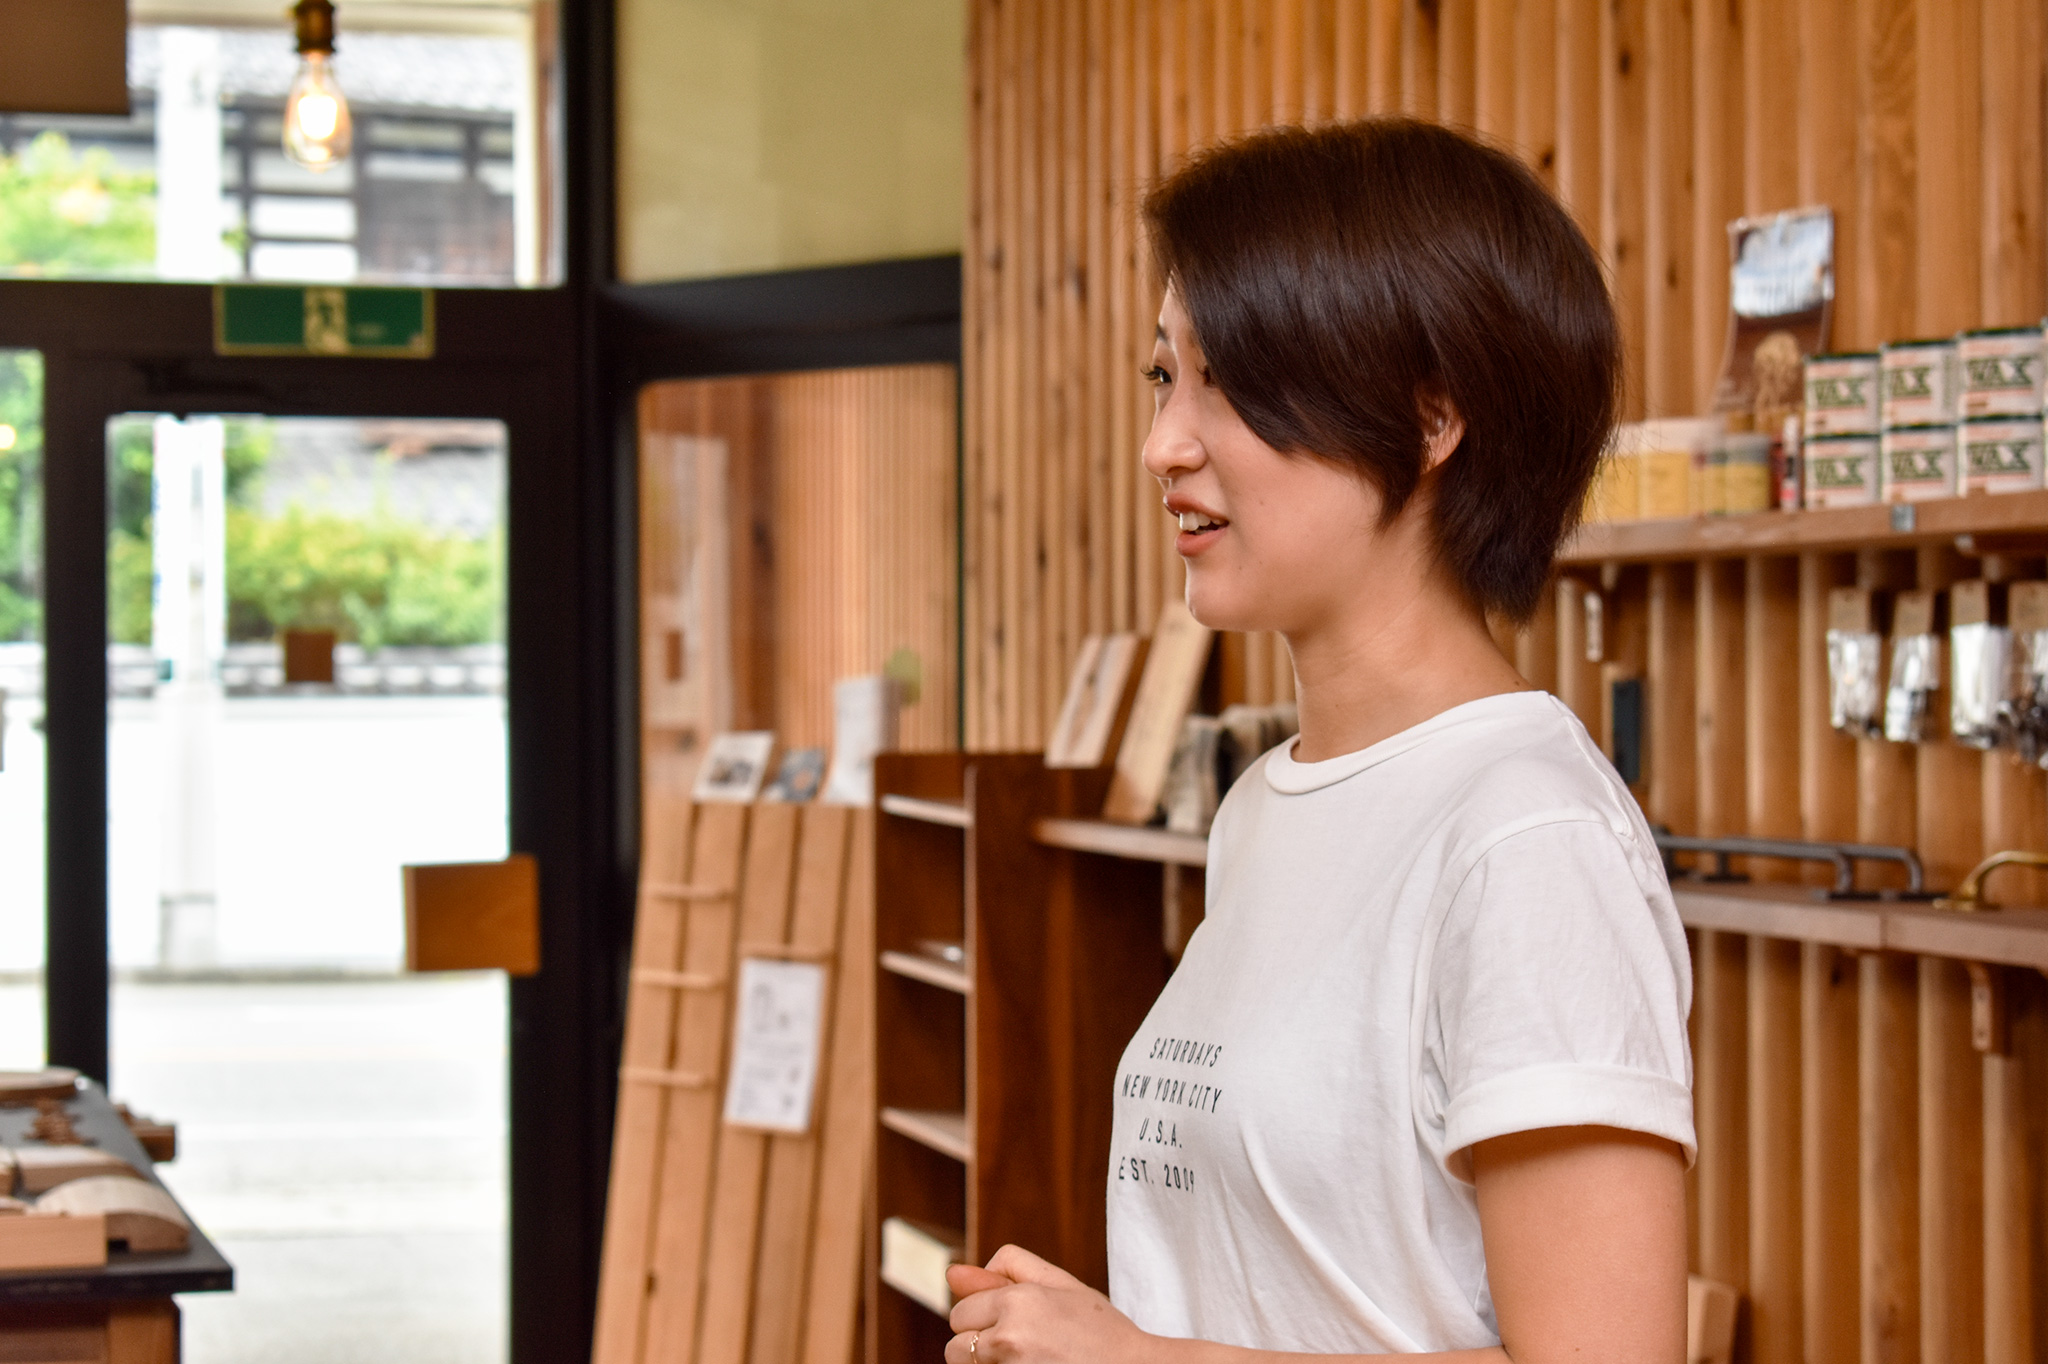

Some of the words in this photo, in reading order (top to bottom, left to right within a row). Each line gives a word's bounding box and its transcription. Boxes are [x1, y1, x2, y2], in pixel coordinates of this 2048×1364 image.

[1149, 1037, 1223, 1069] SATURDAYS
[1122, 1073, 1151, 1100] NEW
[1155, 1077, 1187, 1106] YORK
[1188, 1083, 1223, 1115] CITY
[1139, 1117, 1183, 1149] U.S.A.
[1118, 1156, 1155, 1185] EST.
[1163, 1164, 1195, 1195] 2009
